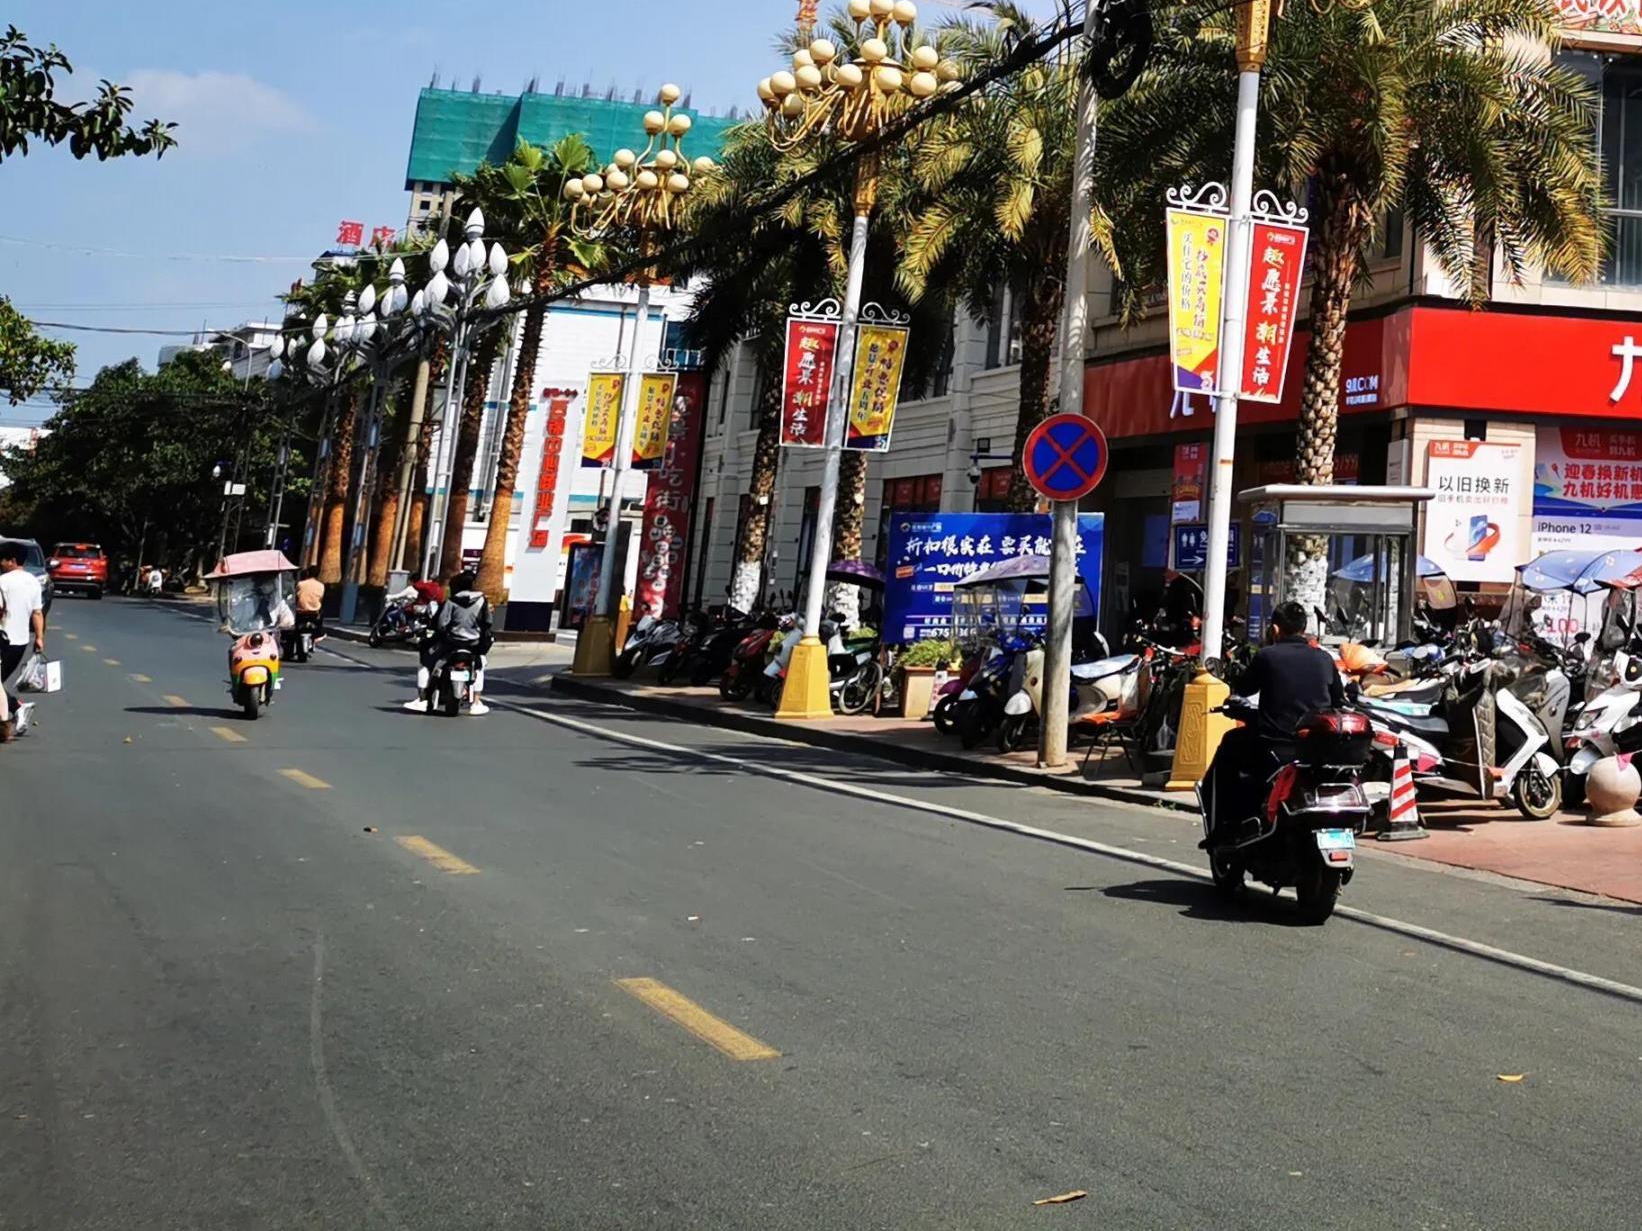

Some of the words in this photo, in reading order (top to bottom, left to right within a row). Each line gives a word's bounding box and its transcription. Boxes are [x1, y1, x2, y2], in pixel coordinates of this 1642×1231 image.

[1439, 475, 1510, 494] 以旧换新
[1537, 521, 1577, 534] iPhone
[1580, 522, 1592, 534] 12
[905, 533, 995, 557] 折扣很实在
[1000, 533, 1088, 557] 要买就在
